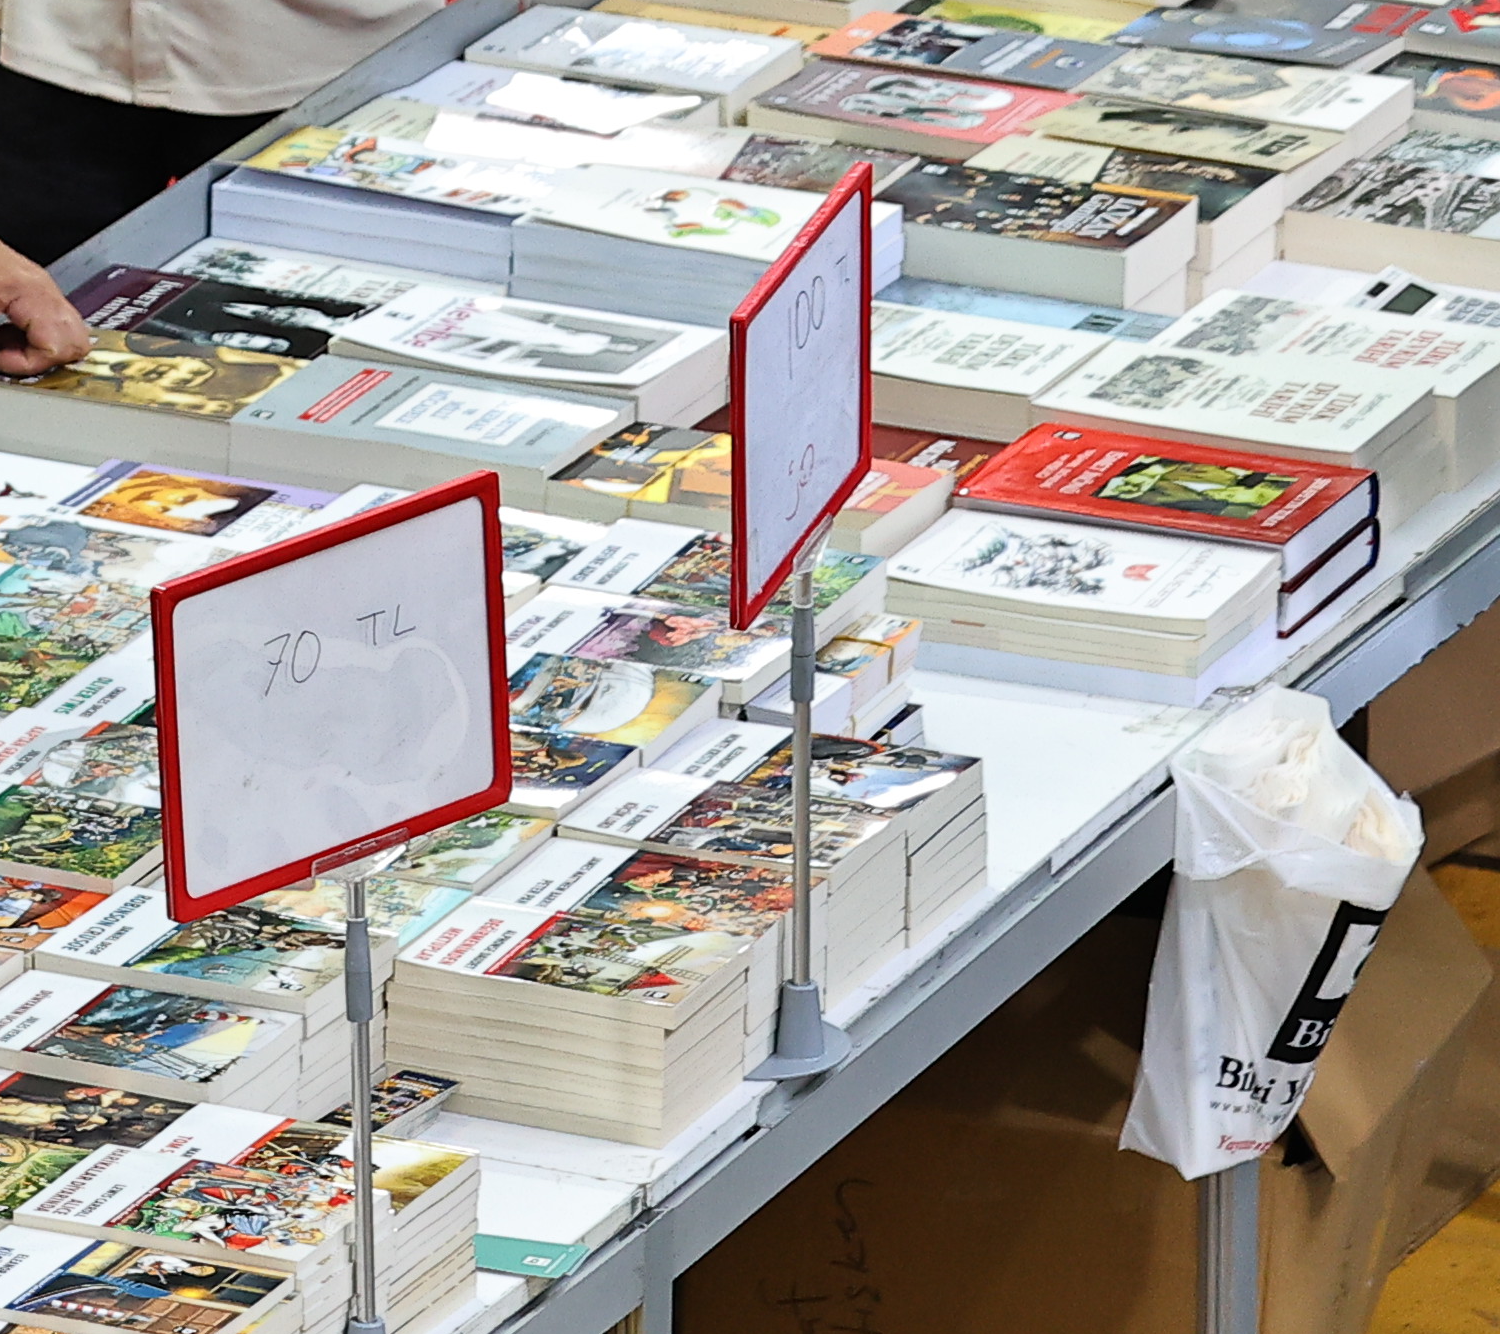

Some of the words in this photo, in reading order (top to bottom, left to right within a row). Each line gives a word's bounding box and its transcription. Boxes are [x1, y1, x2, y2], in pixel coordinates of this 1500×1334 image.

[788, 275, 825, 381] 100
[952, 332, 1024, 373] DEVRİM
[987, 340, 1048, 372] TÜRK
[1348, 327, 1417, 364] TARİHİ
[1373, 329, 1447, 370] DEVRİM
[1408, 338, 1468, 370] TÜRK
[1240, 379, 1312, 419] TARİHİ
[1265, 381, 1344, 425] DEVRİM
[1302, 391, 1366, 424] TÜRK
[264, 629, 322, 697] 70
[357, 604, 417, 646] TL
[95, 893, 153, 926] ROBINSON
[58, 925, 109, 952] CRUSOE
[49, 1197, 84, 1216] ALICE
[96, 1183, 128, 1199] LEWIS
[71, 1198, 108, 1218] CARROLL
